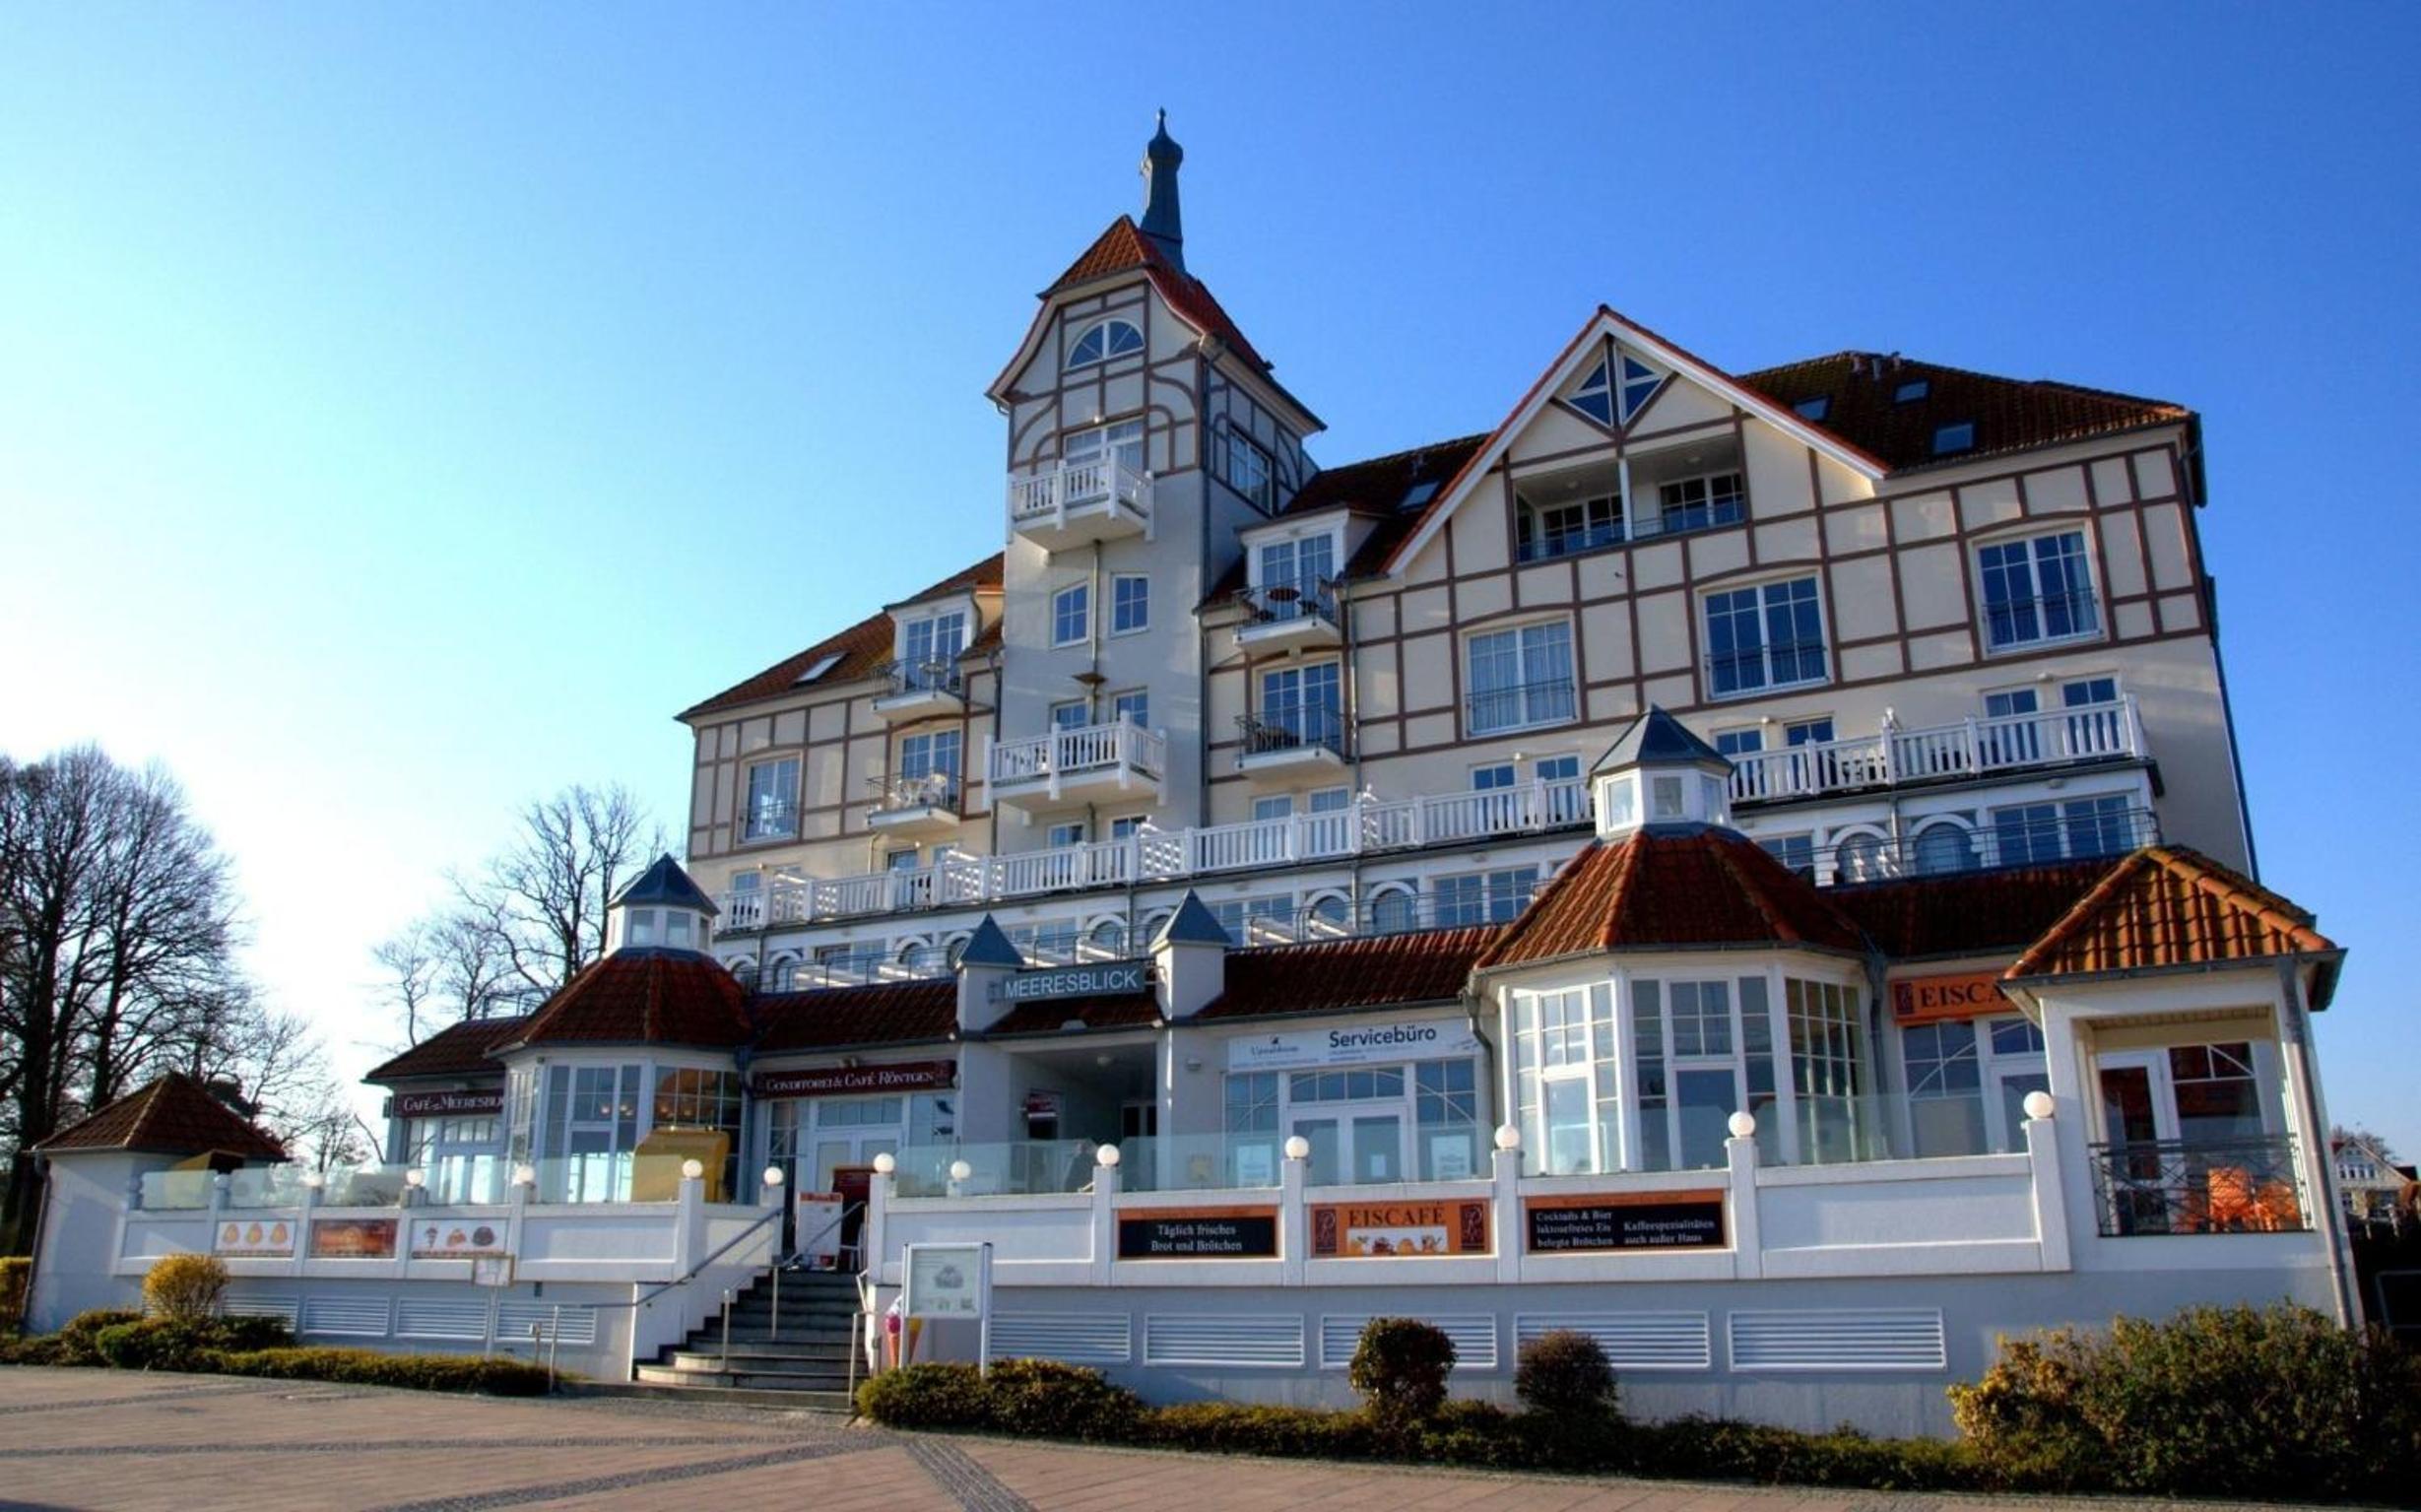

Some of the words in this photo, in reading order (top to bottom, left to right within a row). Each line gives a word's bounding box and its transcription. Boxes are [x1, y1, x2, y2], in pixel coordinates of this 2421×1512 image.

[1005, 970, 1137, 999] MEERESBLICK
[1330, 1024, 1437, 1048] Servicebüro
[844, 1071, 876, 1087] CAFÉ
[879, 1071, 934, 1085] RÖNTGEN
[1348, 1201, 1446, 1227] EISCAFÉ
[1157, 1224, 1194, 1238] Täglich
[1197, 1223, 1236, 1235] frisches
[1150, 1240, 1173, 1252] Brot
[1175, 1240, 1194, 1251] und
[1197, 1237, 1243, 1251] Brötchen
